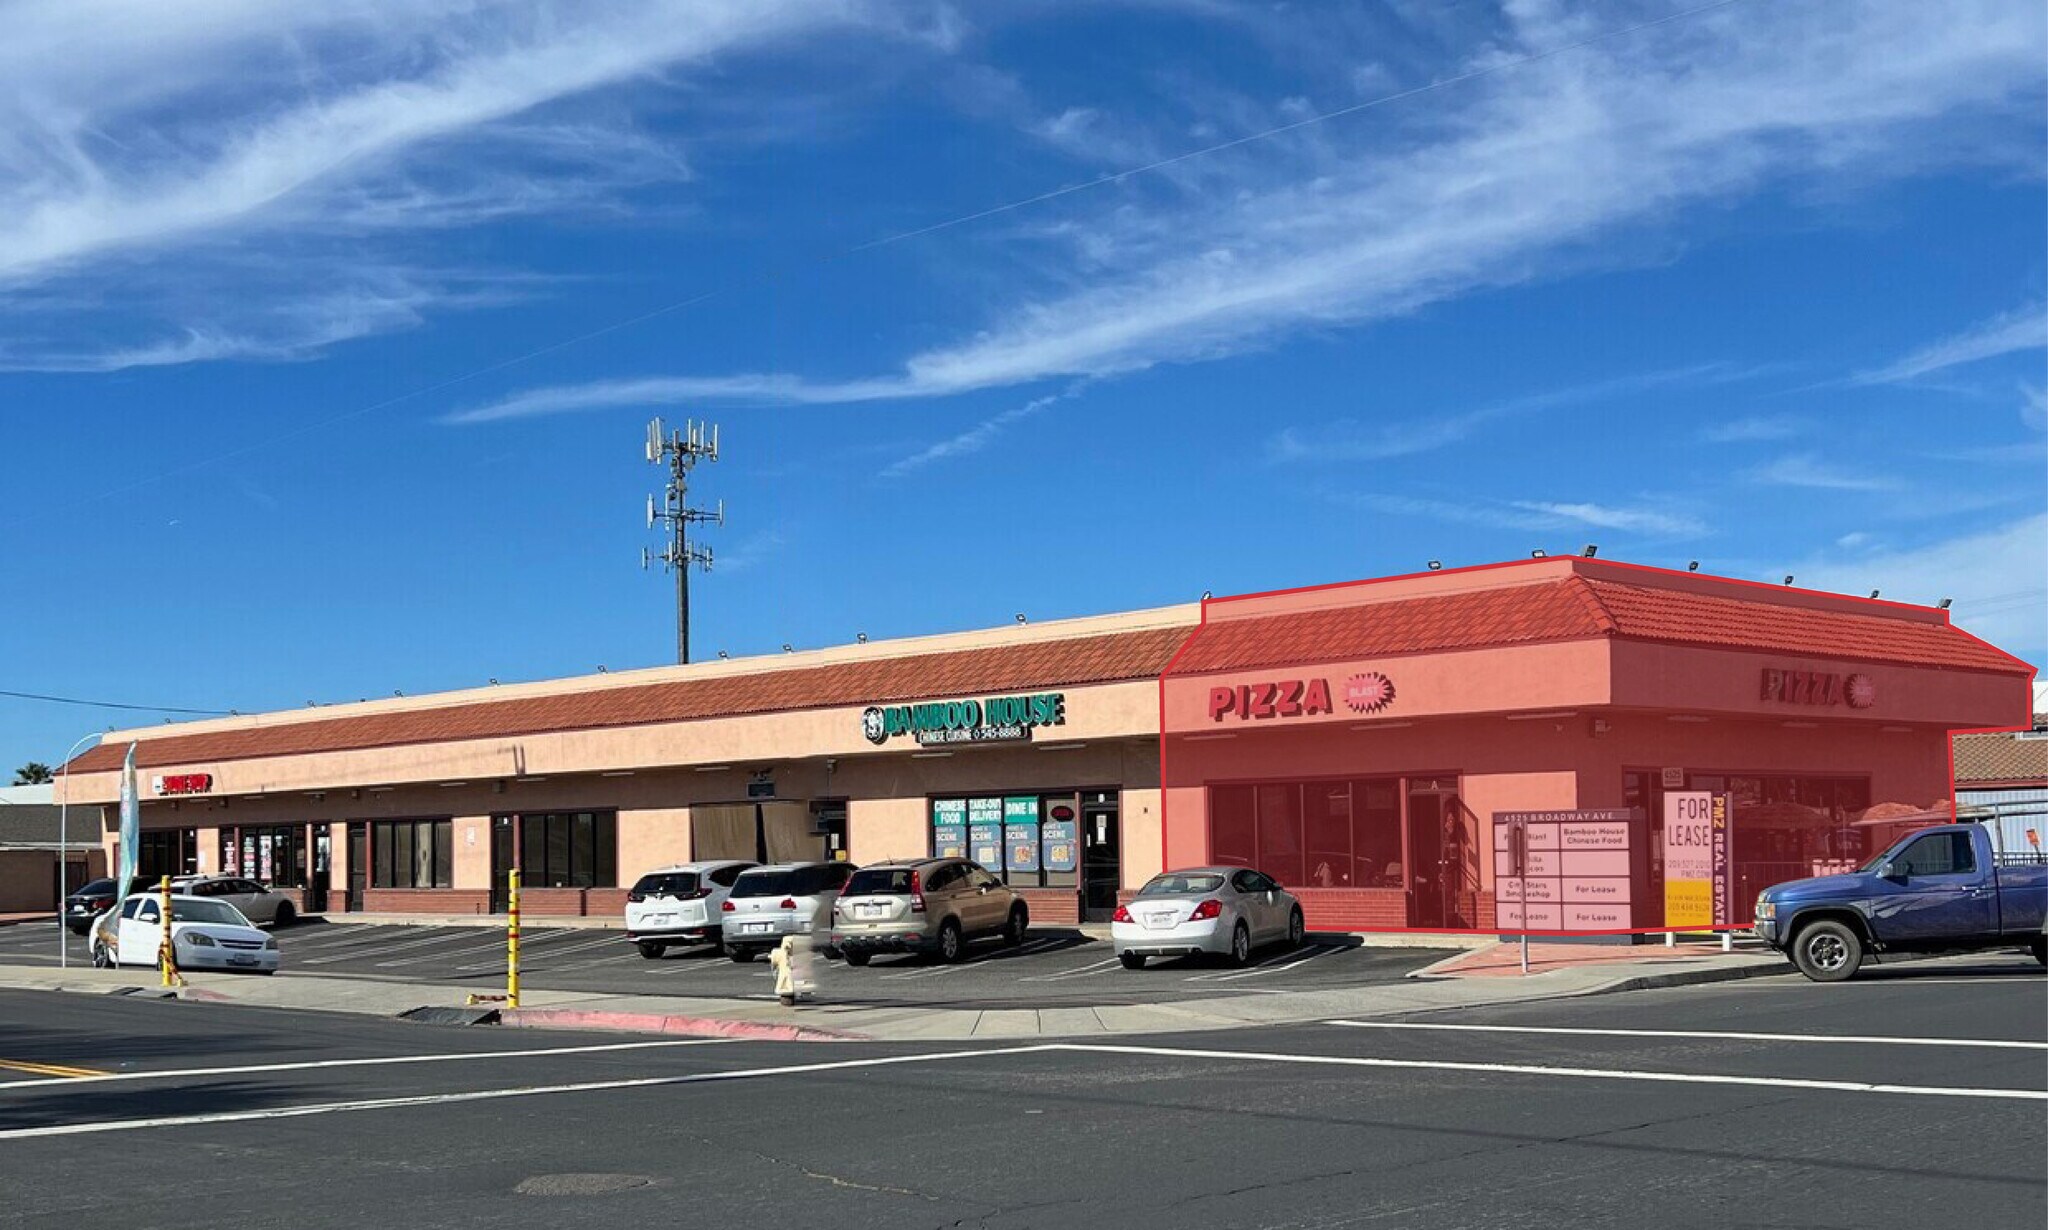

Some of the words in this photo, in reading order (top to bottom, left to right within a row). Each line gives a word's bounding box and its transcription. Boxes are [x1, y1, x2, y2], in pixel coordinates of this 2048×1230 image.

[1761, 668, 1842, 705] PIZZA
[1209, 679, 1331, 719] PIZZA
[885, 700, 980, 734] BAMBOO
[985, 694, 1062, 725] HOUSE
[934, 801, 966, 812] CHINESE
[1006, 802, 1026, 815] DINE
[1678, 798, 1709, 819] FOR
[1713, 797, 1725, 828] PMZ
[941, 812, 961, 824] FOOD
[1530, 812, 1589, 822] BROADWAY
[1564, 828, 1597, 836] Bamboo
[1599, 827, 1625, 835] House
[1669, 825, 1710, 846] LEASE
[1602, 836, 1622, 844] Food
[1714, 833, 1725, 870] REAL
[1575, 885, 1589, 893] For
[1714, 875, 1725, 925] ESTATE
[1524, 912, 1549, 920] ease
[1576, 913, 1589, 921] For
[1592, 913, 1617, 921] Lease
